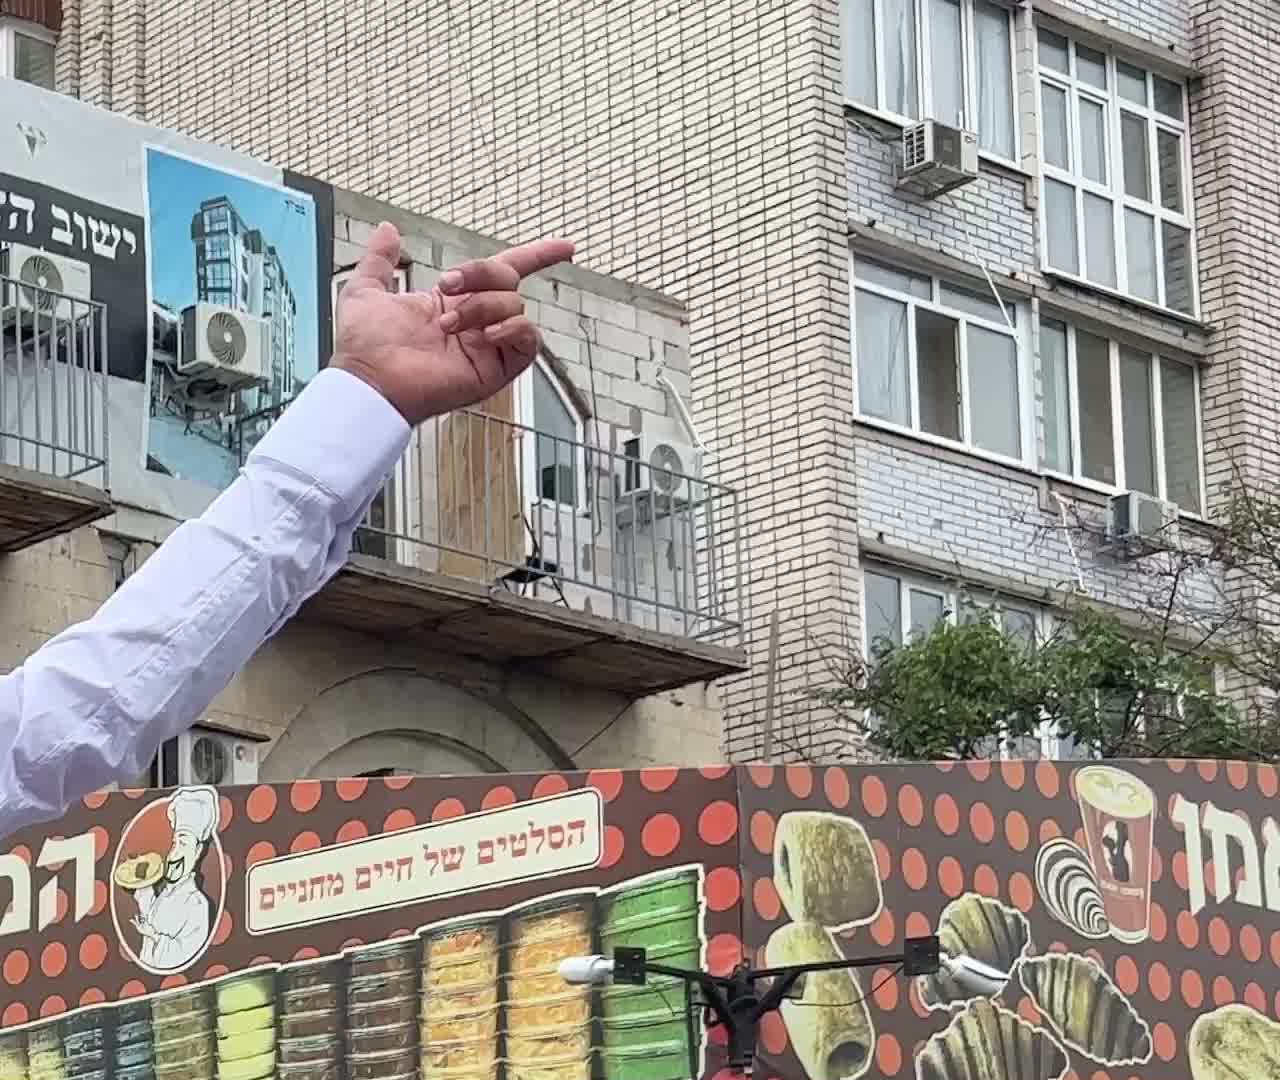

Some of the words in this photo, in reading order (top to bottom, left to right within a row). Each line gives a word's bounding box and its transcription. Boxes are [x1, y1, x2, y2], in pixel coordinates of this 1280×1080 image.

[50, 203, 138, 260] ישוב
[423, 844, 465, 877] של
[477, 819, 586, 865] הסלטים
[259, 872, 344, 911] מחניים
[355, 856, 413, 890] חיים
